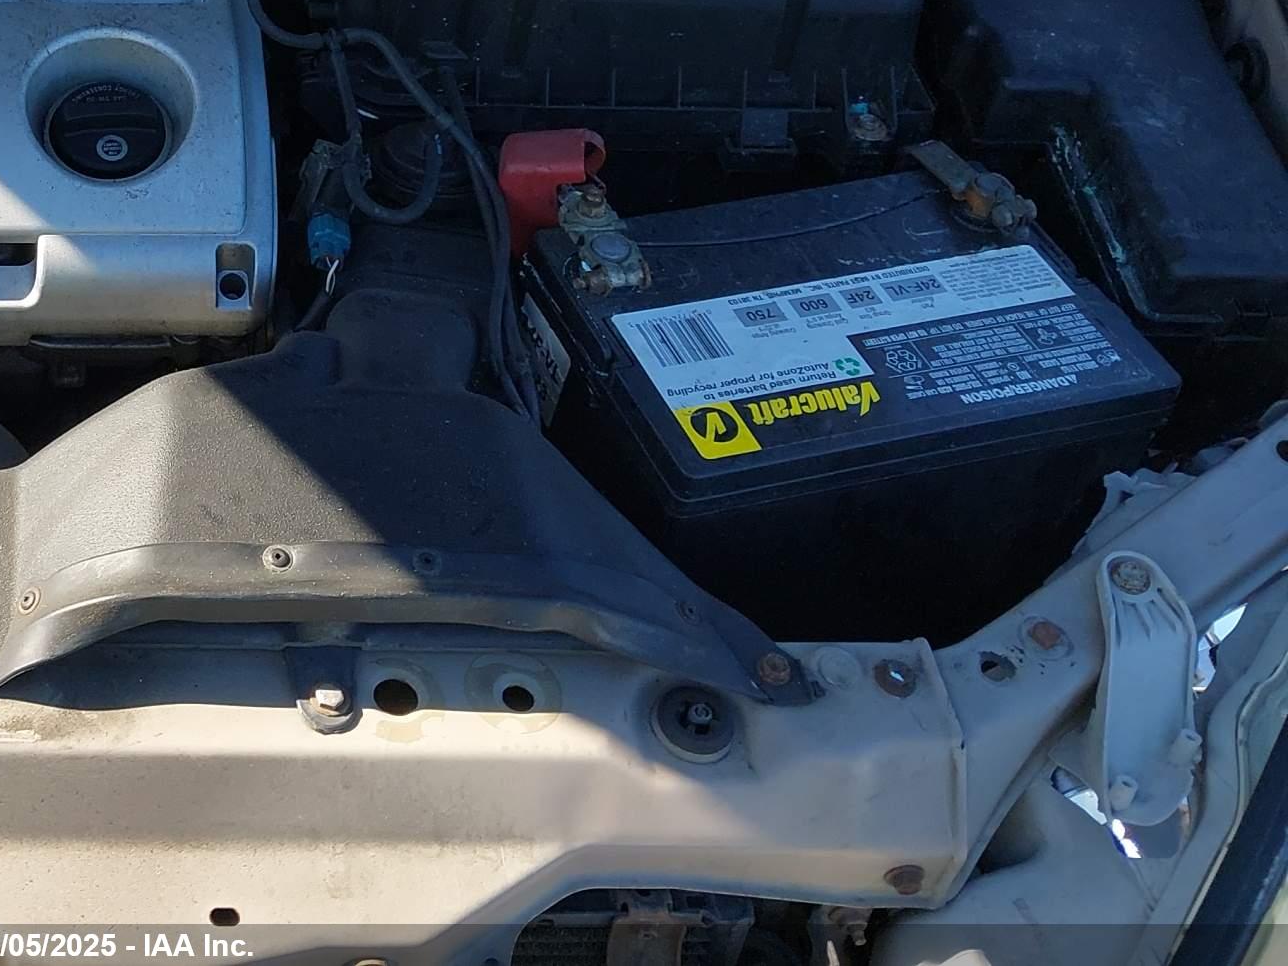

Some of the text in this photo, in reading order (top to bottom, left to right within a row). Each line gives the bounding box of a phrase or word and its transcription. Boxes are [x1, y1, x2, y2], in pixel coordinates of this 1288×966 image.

[881, 266, 930, 278] DISTRIBUTED
[846, 289, 875, 303] 24F
[885, 278, 941, 296] 24F-VL
[800, 298, 828, 311] 600
[746, 308, 774, 323] 750
[666, 362, 829, 398] AutoZone for proper recycling
[703, 371, 836, 401] Return used batteries to
[960, 374, 1066, 403] DANGER/POISON
[744, 381, 881, 425] Valucraft
